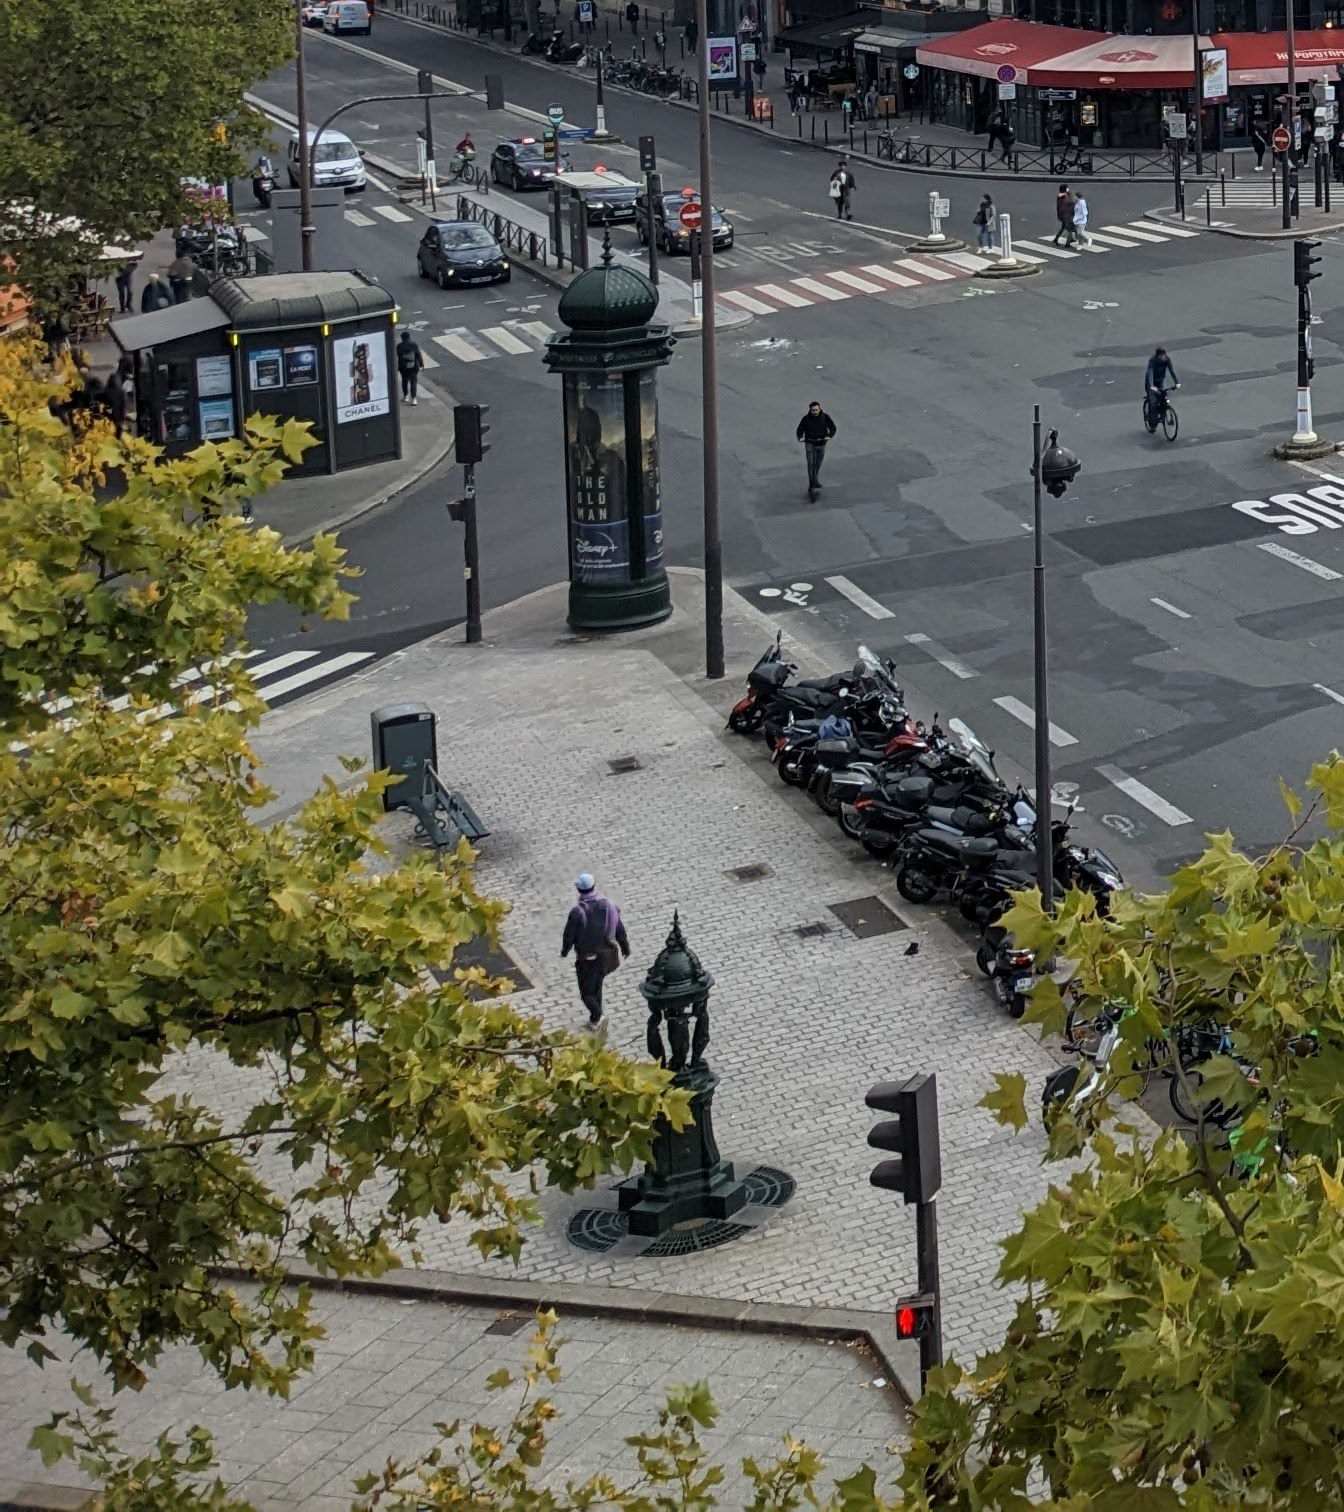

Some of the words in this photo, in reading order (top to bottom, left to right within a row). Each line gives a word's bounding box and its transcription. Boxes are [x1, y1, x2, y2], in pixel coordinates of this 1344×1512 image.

[753, 240, 847, 261] BUS
[344, 404, 382, 419] CHANEL
[576, 475, 606, 489] THE
[576, 492, 606, 506] OLD
[576, 507, 608, 521] MAN
